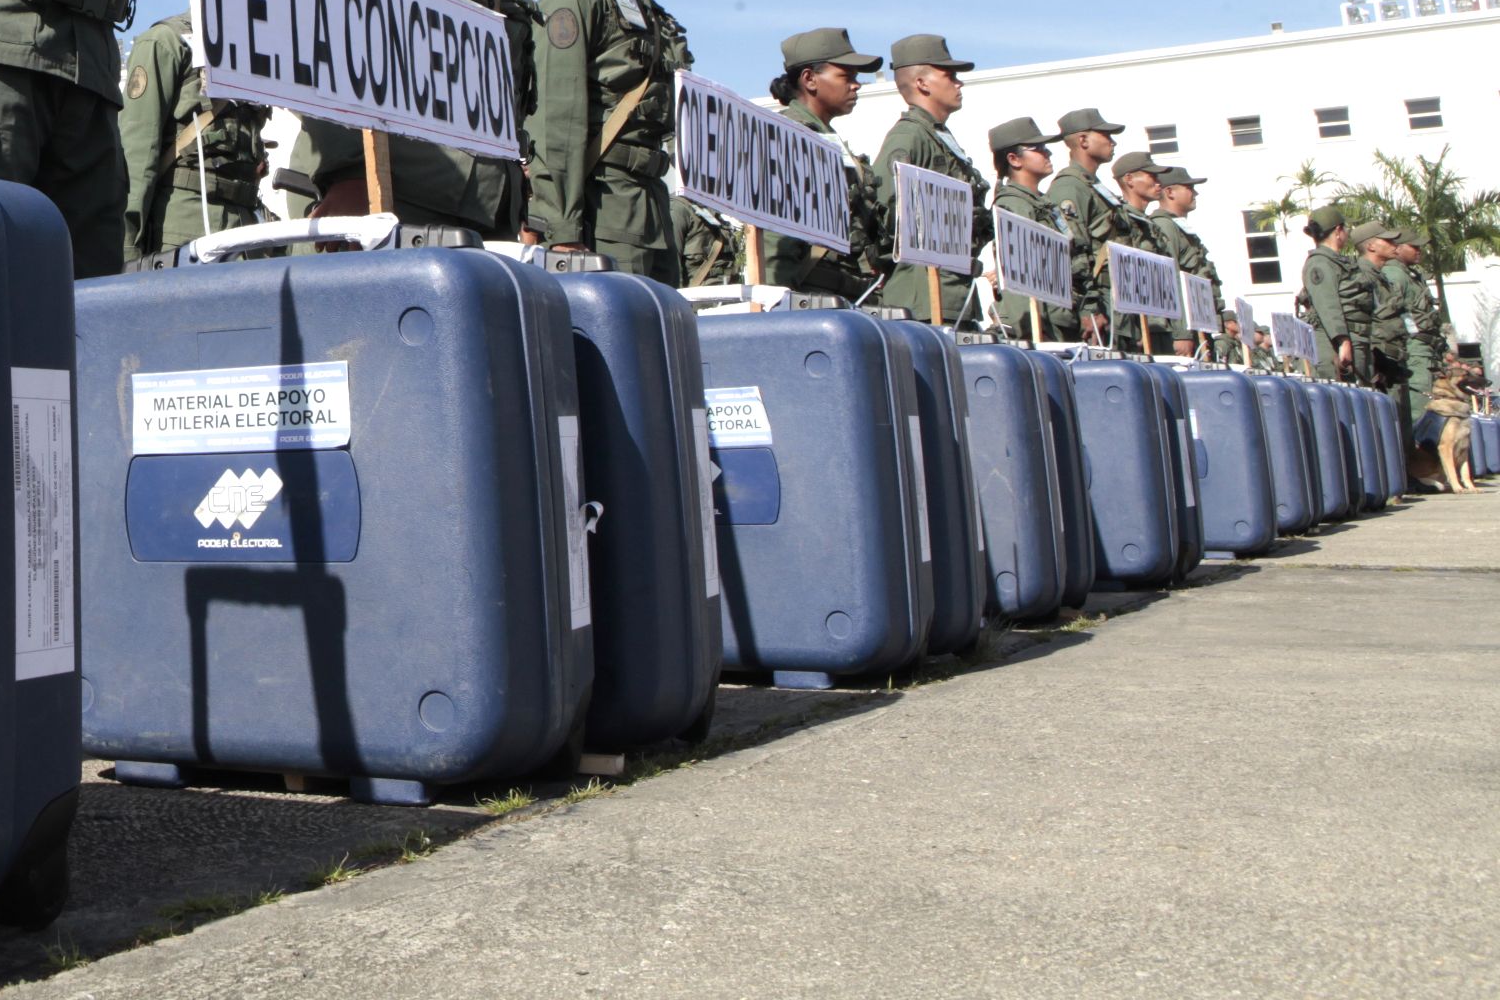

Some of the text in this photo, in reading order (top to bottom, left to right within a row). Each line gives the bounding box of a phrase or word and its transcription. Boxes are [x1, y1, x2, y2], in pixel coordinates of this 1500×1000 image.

[677, 85, 850, 241] COLEGIO PROMESAS PATRIAS
[153, 389, 325, 411] MATERIAL DE APOYO
[707, 405, 752, 416] APOYO
[144, 410, 337, 431] Y UTILERÍA ELECTORAL
[709, 419, 761, 430] CTORAL
[198, 539, 282, 548] PODER ELECTORAL
